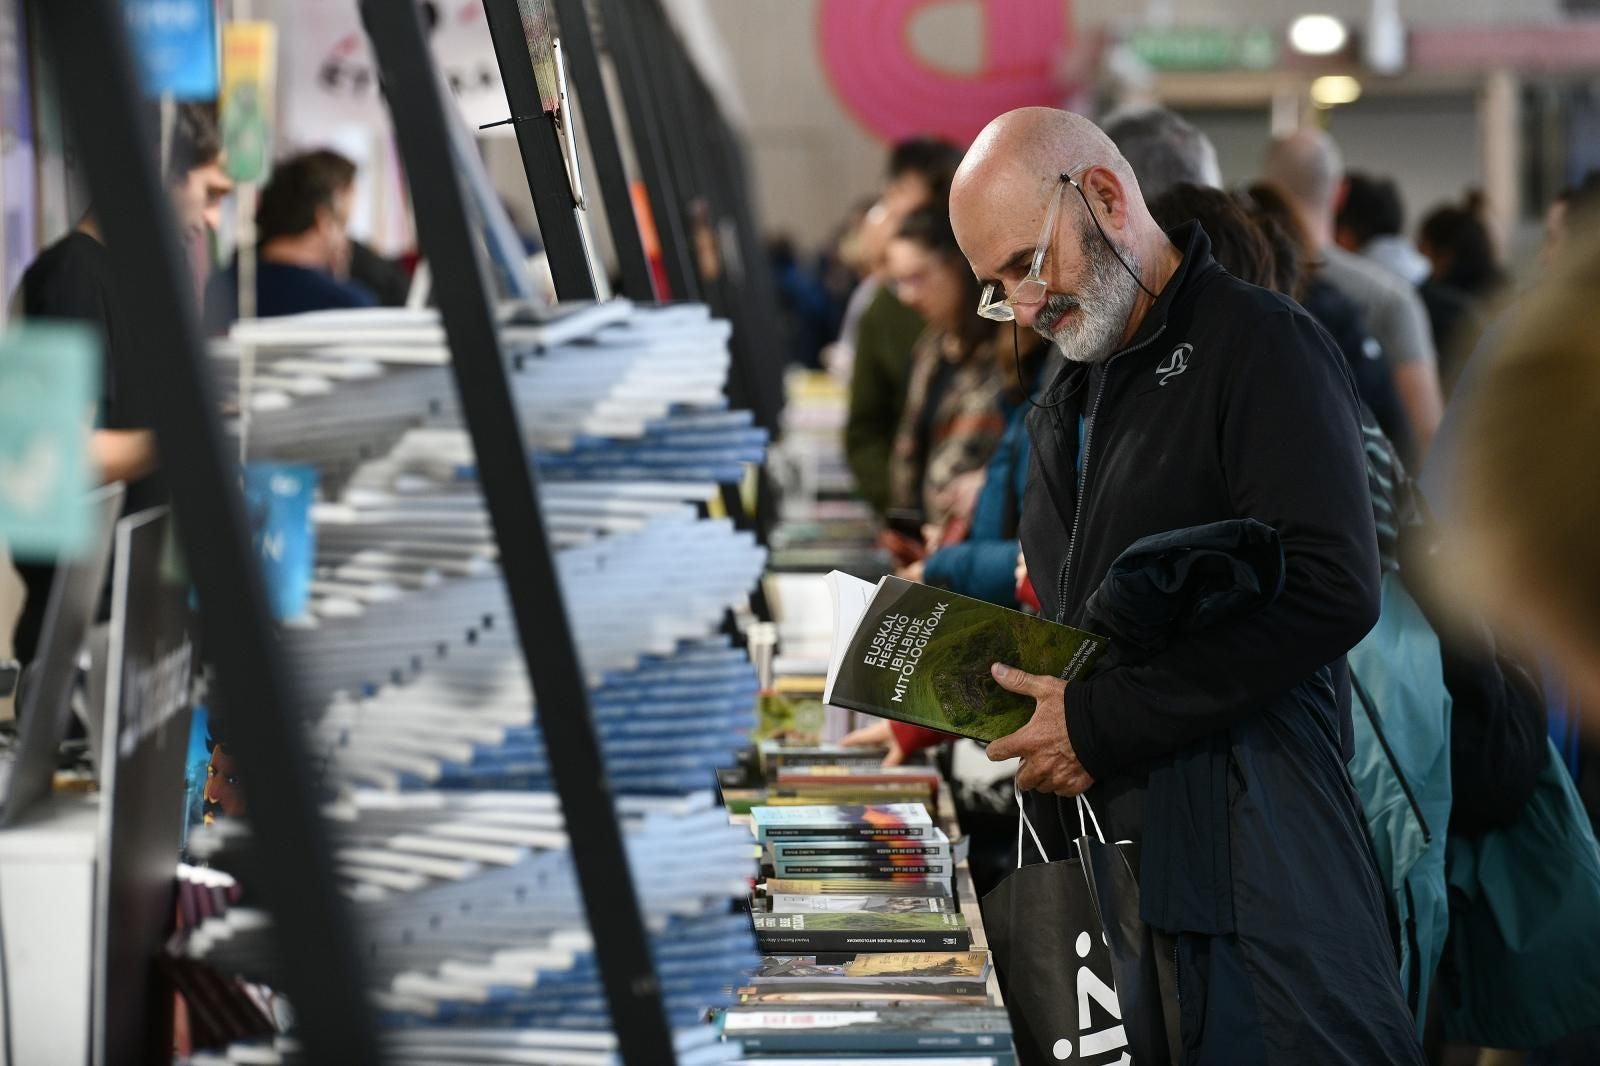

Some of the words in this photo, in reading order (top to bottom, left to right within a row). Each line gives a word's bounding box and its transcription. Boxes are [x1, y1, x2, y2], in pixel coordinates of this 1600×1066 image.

[863, 613, 900, 666] EUSKAL
[876, 615, 909, 669] HERRIKO
[889, 617, 925, 672] IBILBIDE
[890, 602, 949, 703] MITOLOGIKOAK
